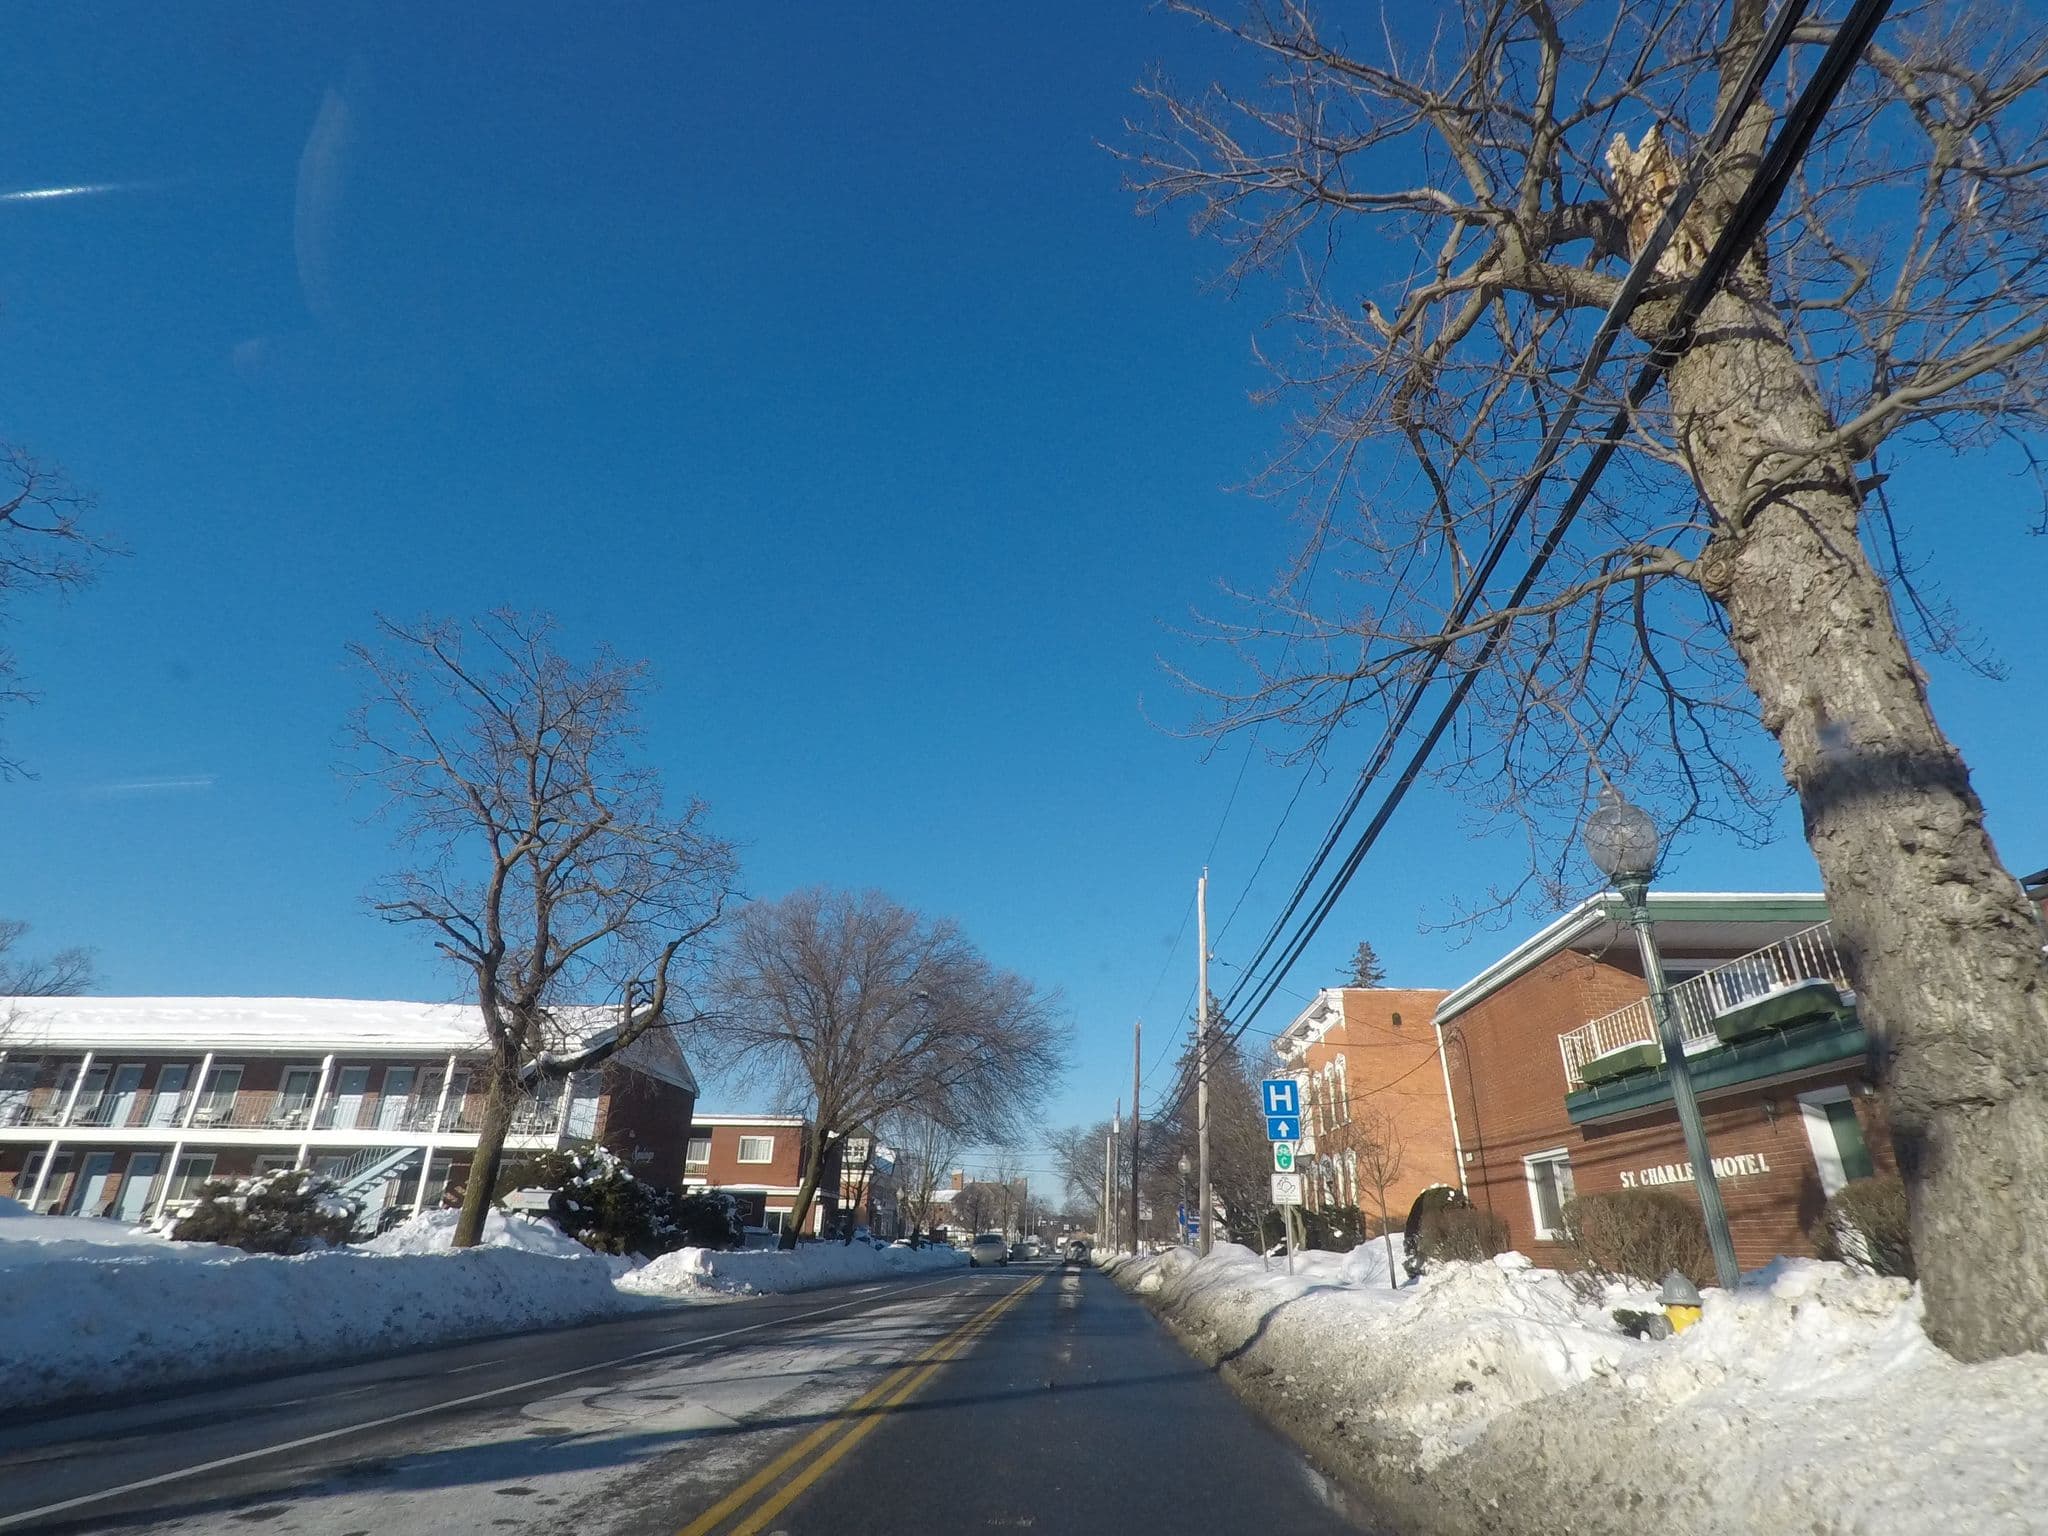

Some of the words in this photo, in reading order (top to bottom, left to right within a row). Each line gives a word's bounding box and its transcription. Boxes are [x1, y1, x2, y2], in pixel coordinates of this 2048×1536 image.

[1269, 1085, 1293, 1112] H
[1620, 1171, 1639, 1187] ST.
[1640, 1162, 1697, 1186] CHARLE
[1711, 1153, 1771, 1178] MOTEL
